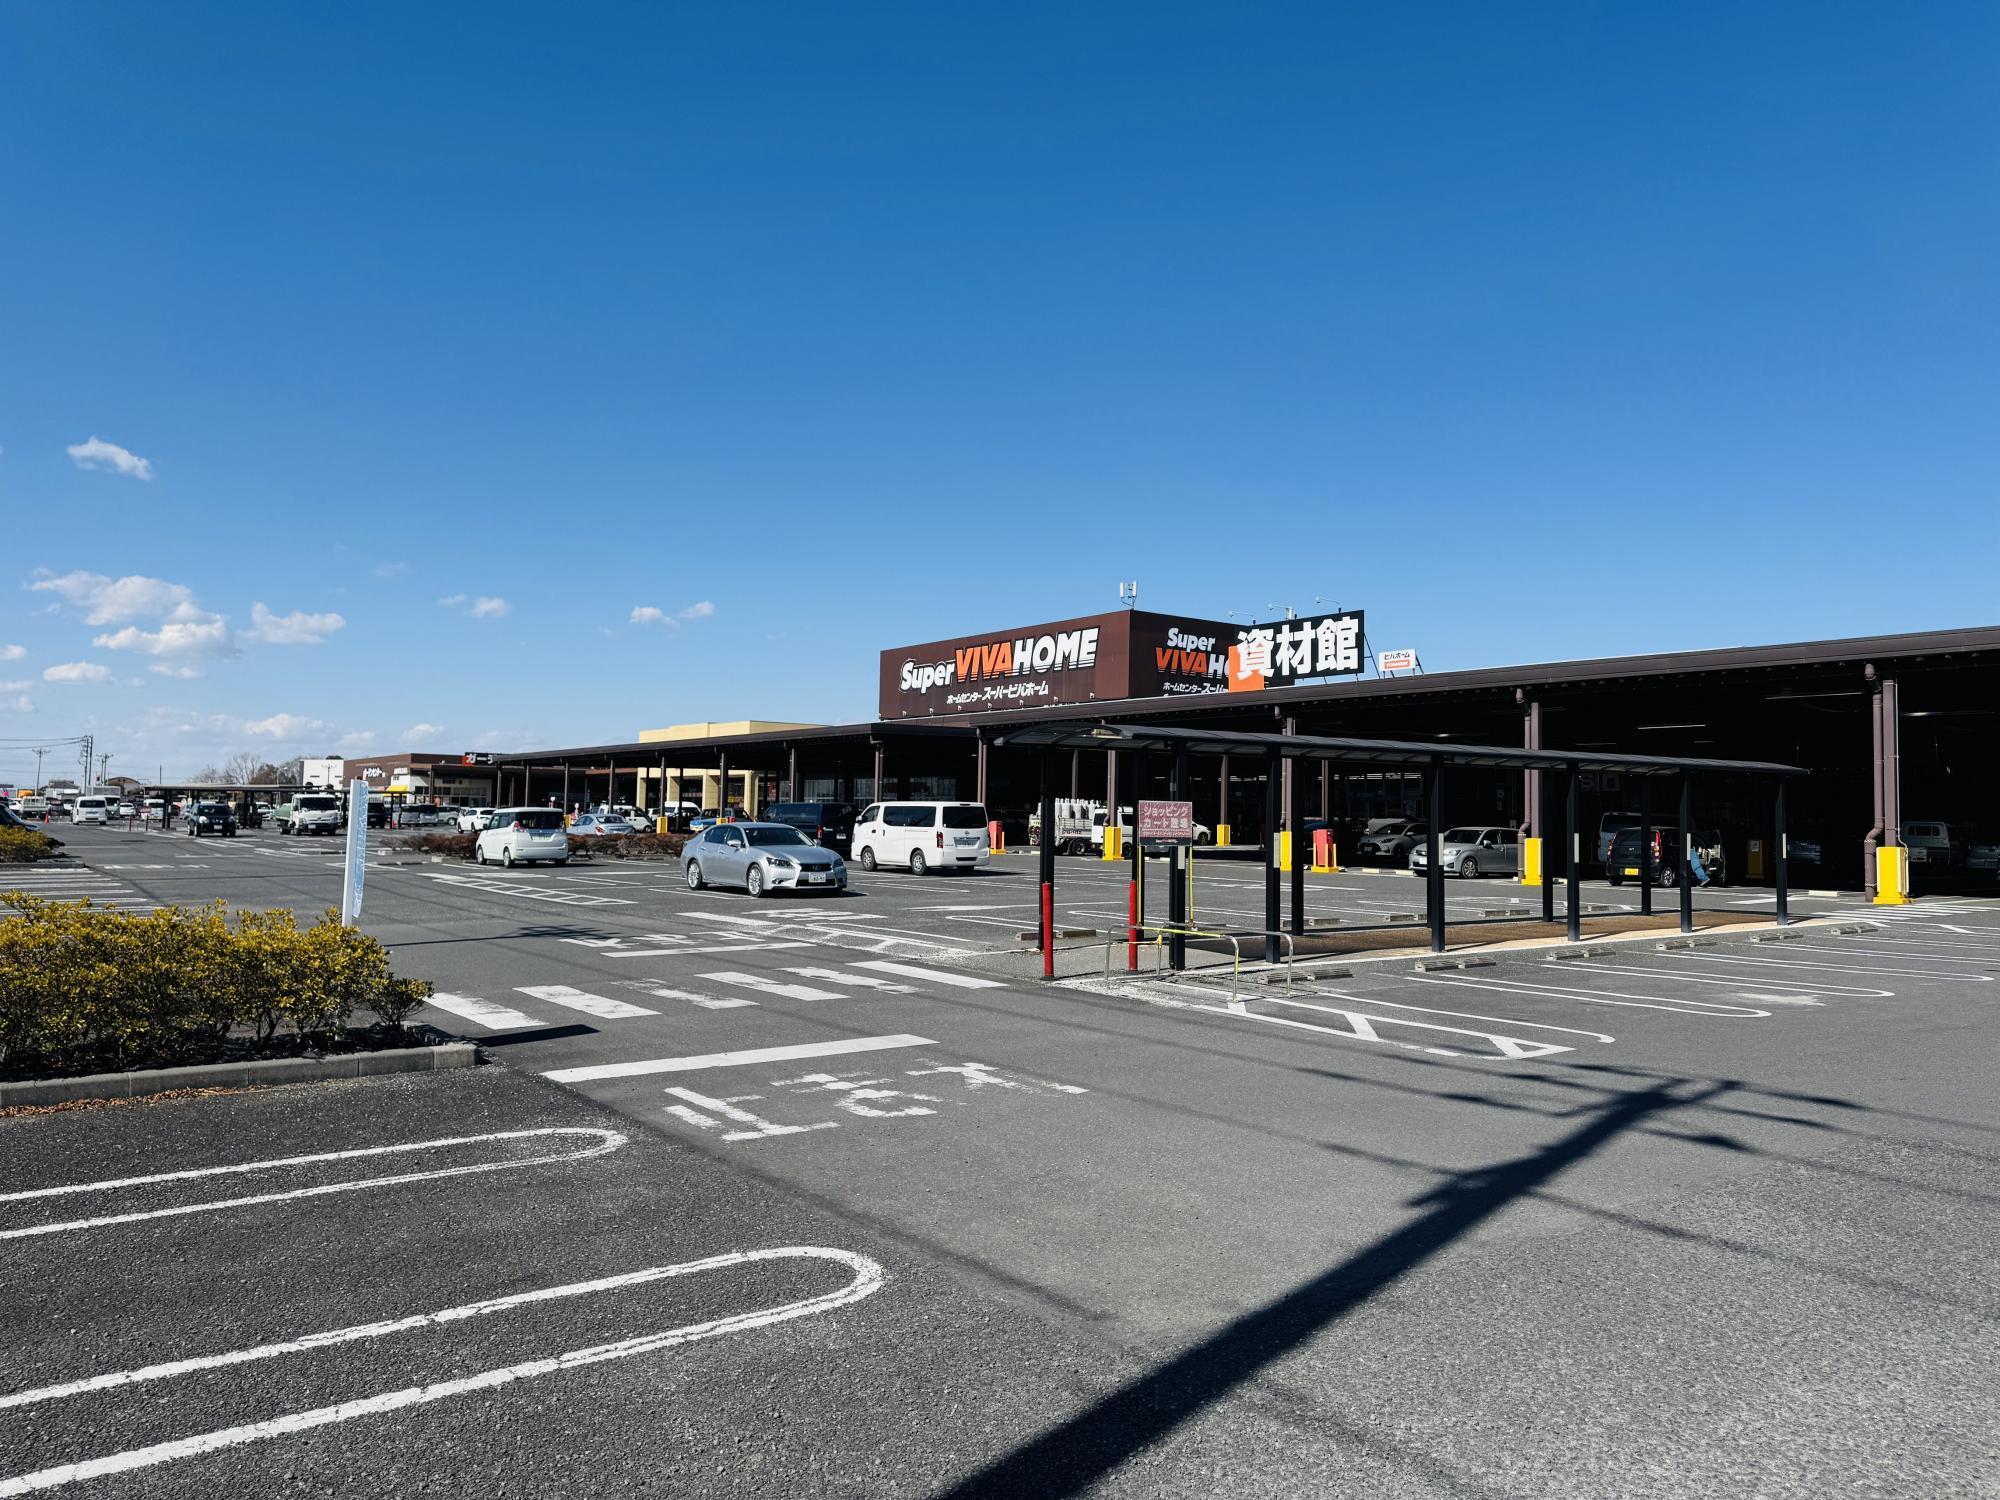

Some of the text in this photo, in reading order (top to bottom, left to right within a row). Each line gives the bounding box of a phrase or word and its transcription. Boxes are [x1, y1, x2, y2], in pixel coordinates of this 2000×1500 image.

[1167, 627, 1216, 652] Super
[1237, 616, 1360, 681] 資材館
[664, 1058, 1090, 1142] 止まれ
